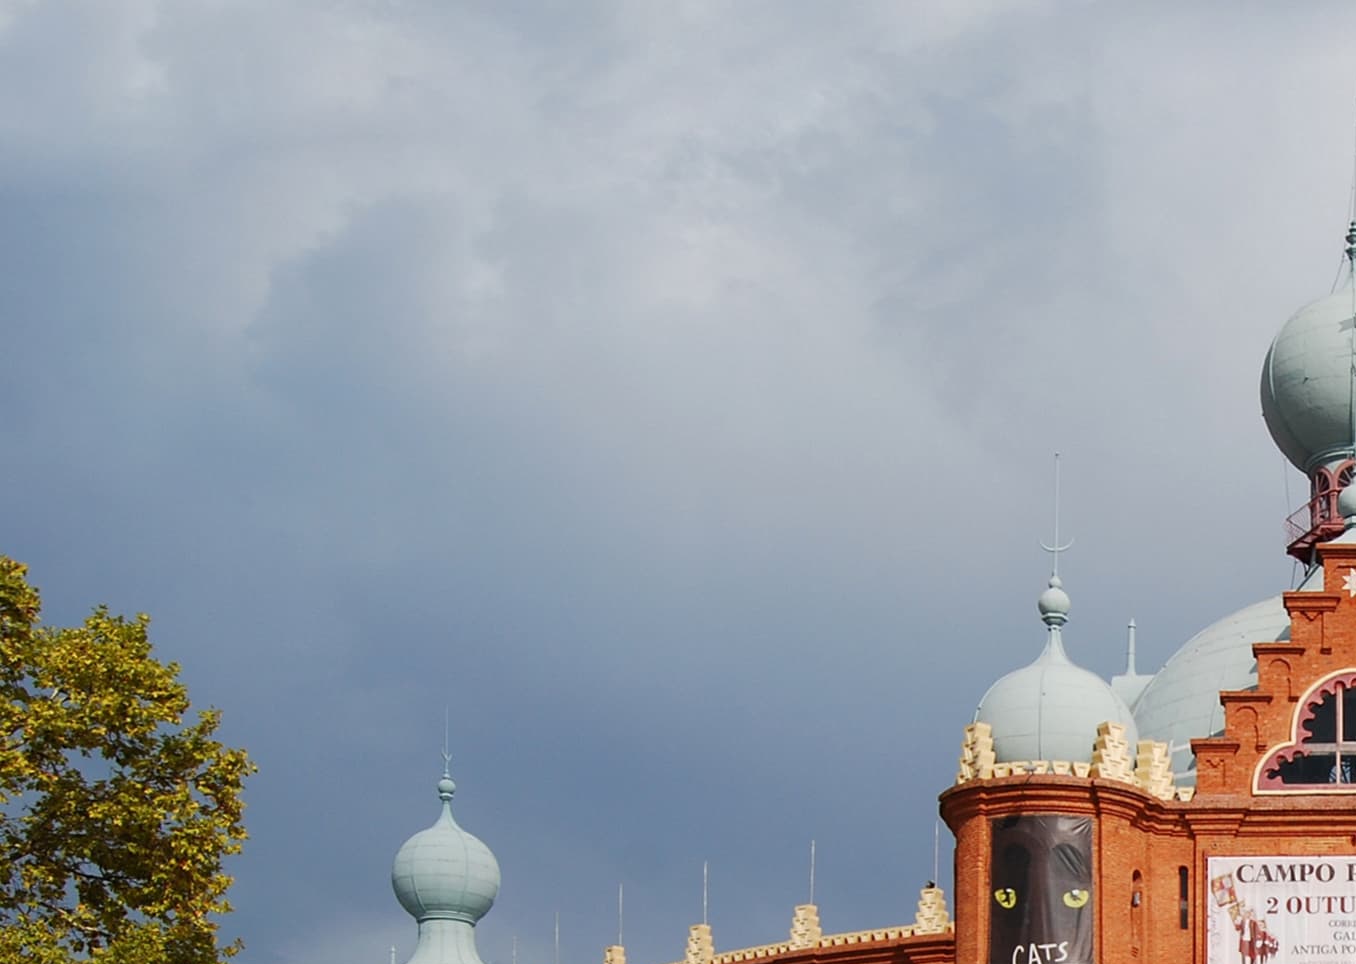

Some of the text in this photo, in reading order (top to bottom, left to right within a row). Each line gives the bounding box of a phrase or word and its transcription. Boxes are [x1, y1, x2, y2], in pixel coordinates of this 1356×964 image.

[1236, 863, 1336, 884] CAMPO
[1266, 896, 1279, 915] 2
[1291, 944, 1338, 955] ANTIGA
